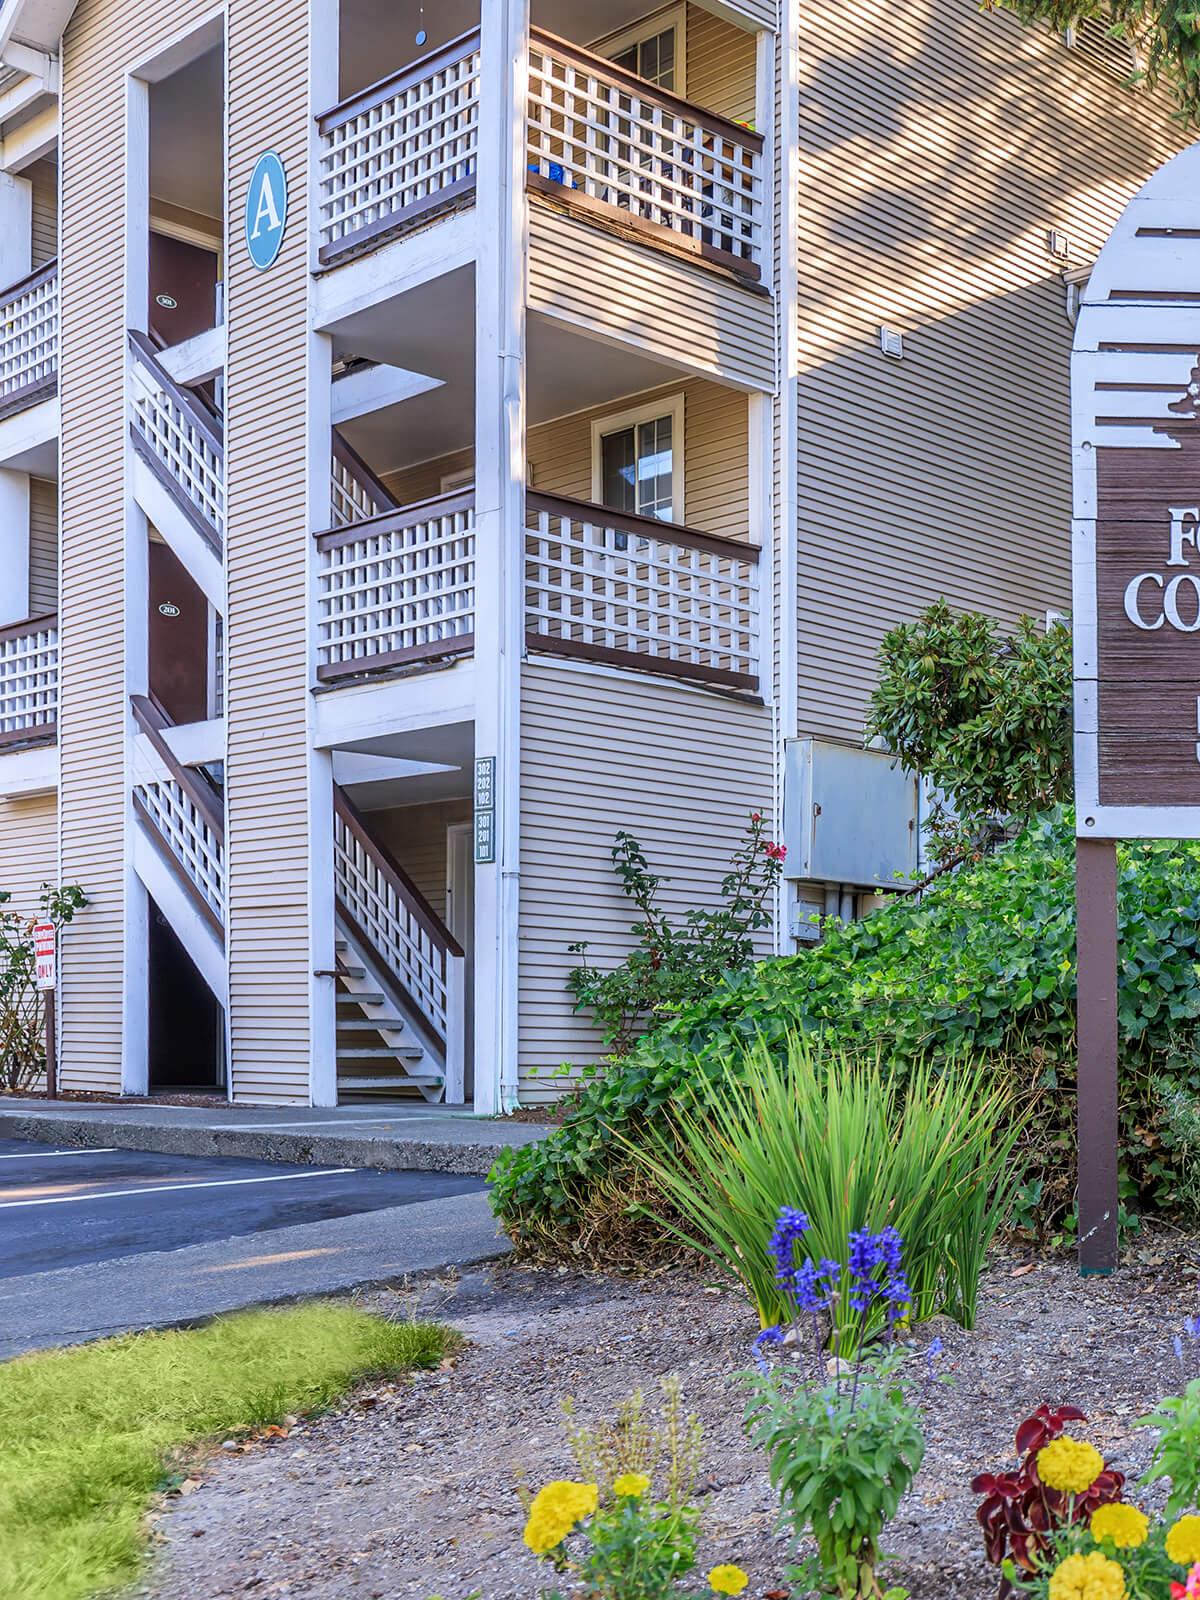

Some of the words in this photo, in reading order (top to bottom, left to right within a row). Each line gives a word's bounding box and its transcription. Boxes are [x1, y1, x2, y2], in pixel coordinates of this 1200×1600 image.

[250, 172, 282, 241] A
[477, 762, 490, 775] 302
[477, 776, 490, 789] 202
[478, 791, 490, 804] 102
[478, 815, 490, 828] 301
[478, 830, 490, 842] 201
[479, 844, 489, 857] 101
[38, 964, 52, 979] ONLY
